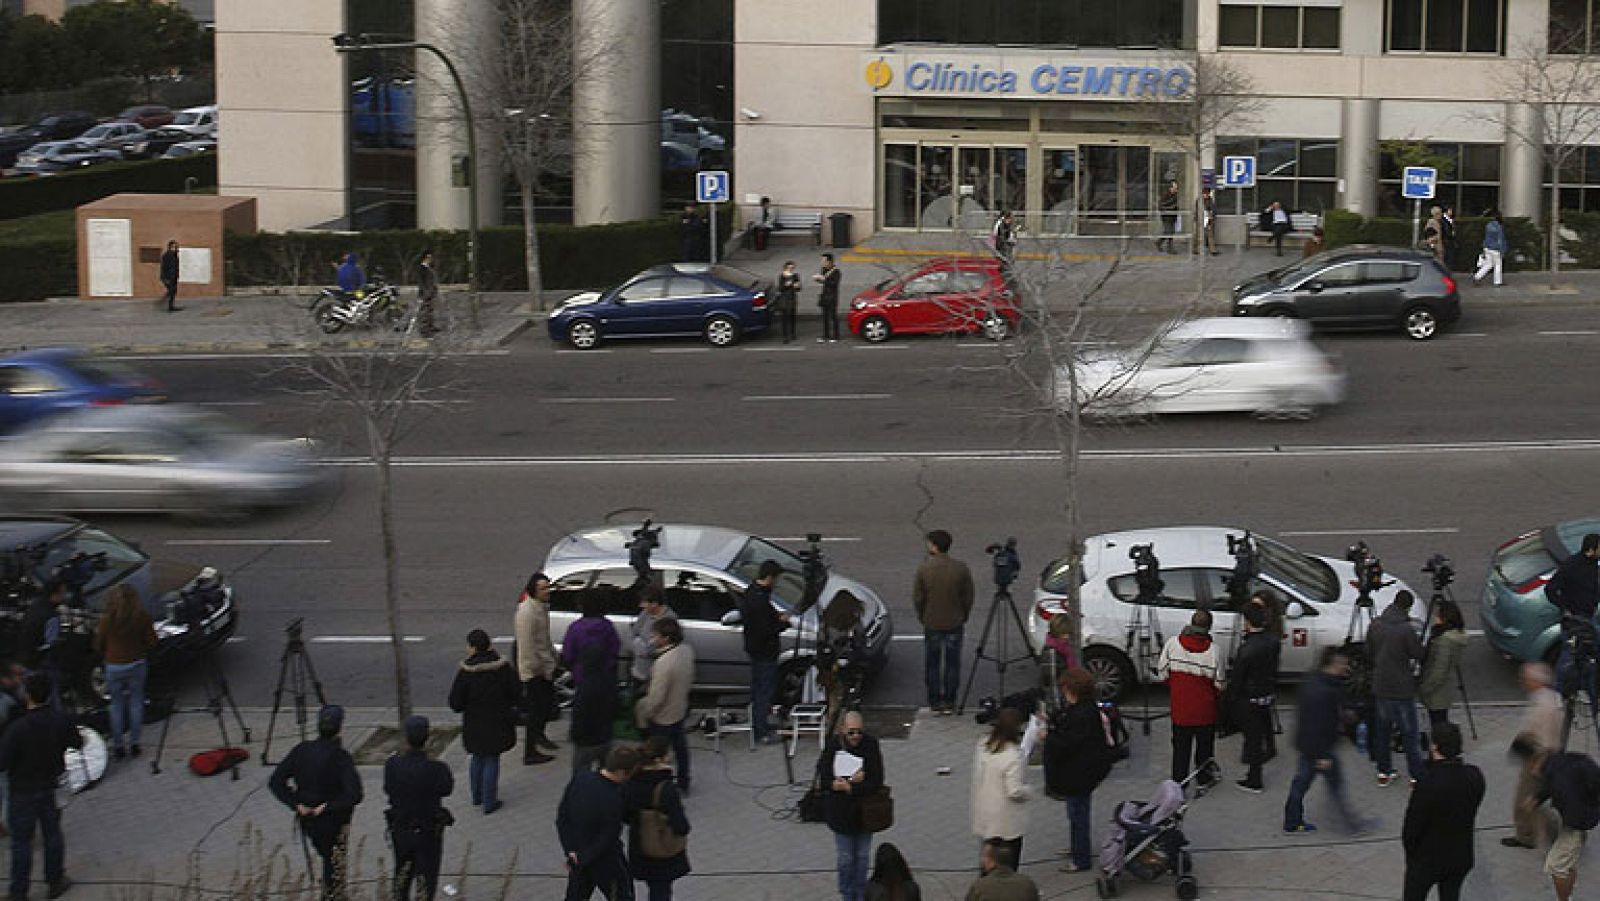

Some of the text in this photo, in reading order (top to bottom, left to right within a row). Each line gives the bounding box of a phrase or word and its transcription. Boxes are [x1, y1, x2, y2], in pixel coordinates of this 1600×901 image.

[905, 62, 1191, 96] Clínica CEMTRO
[1231, 160, 1246, 182] P
[704, 176, 719, 198] P
